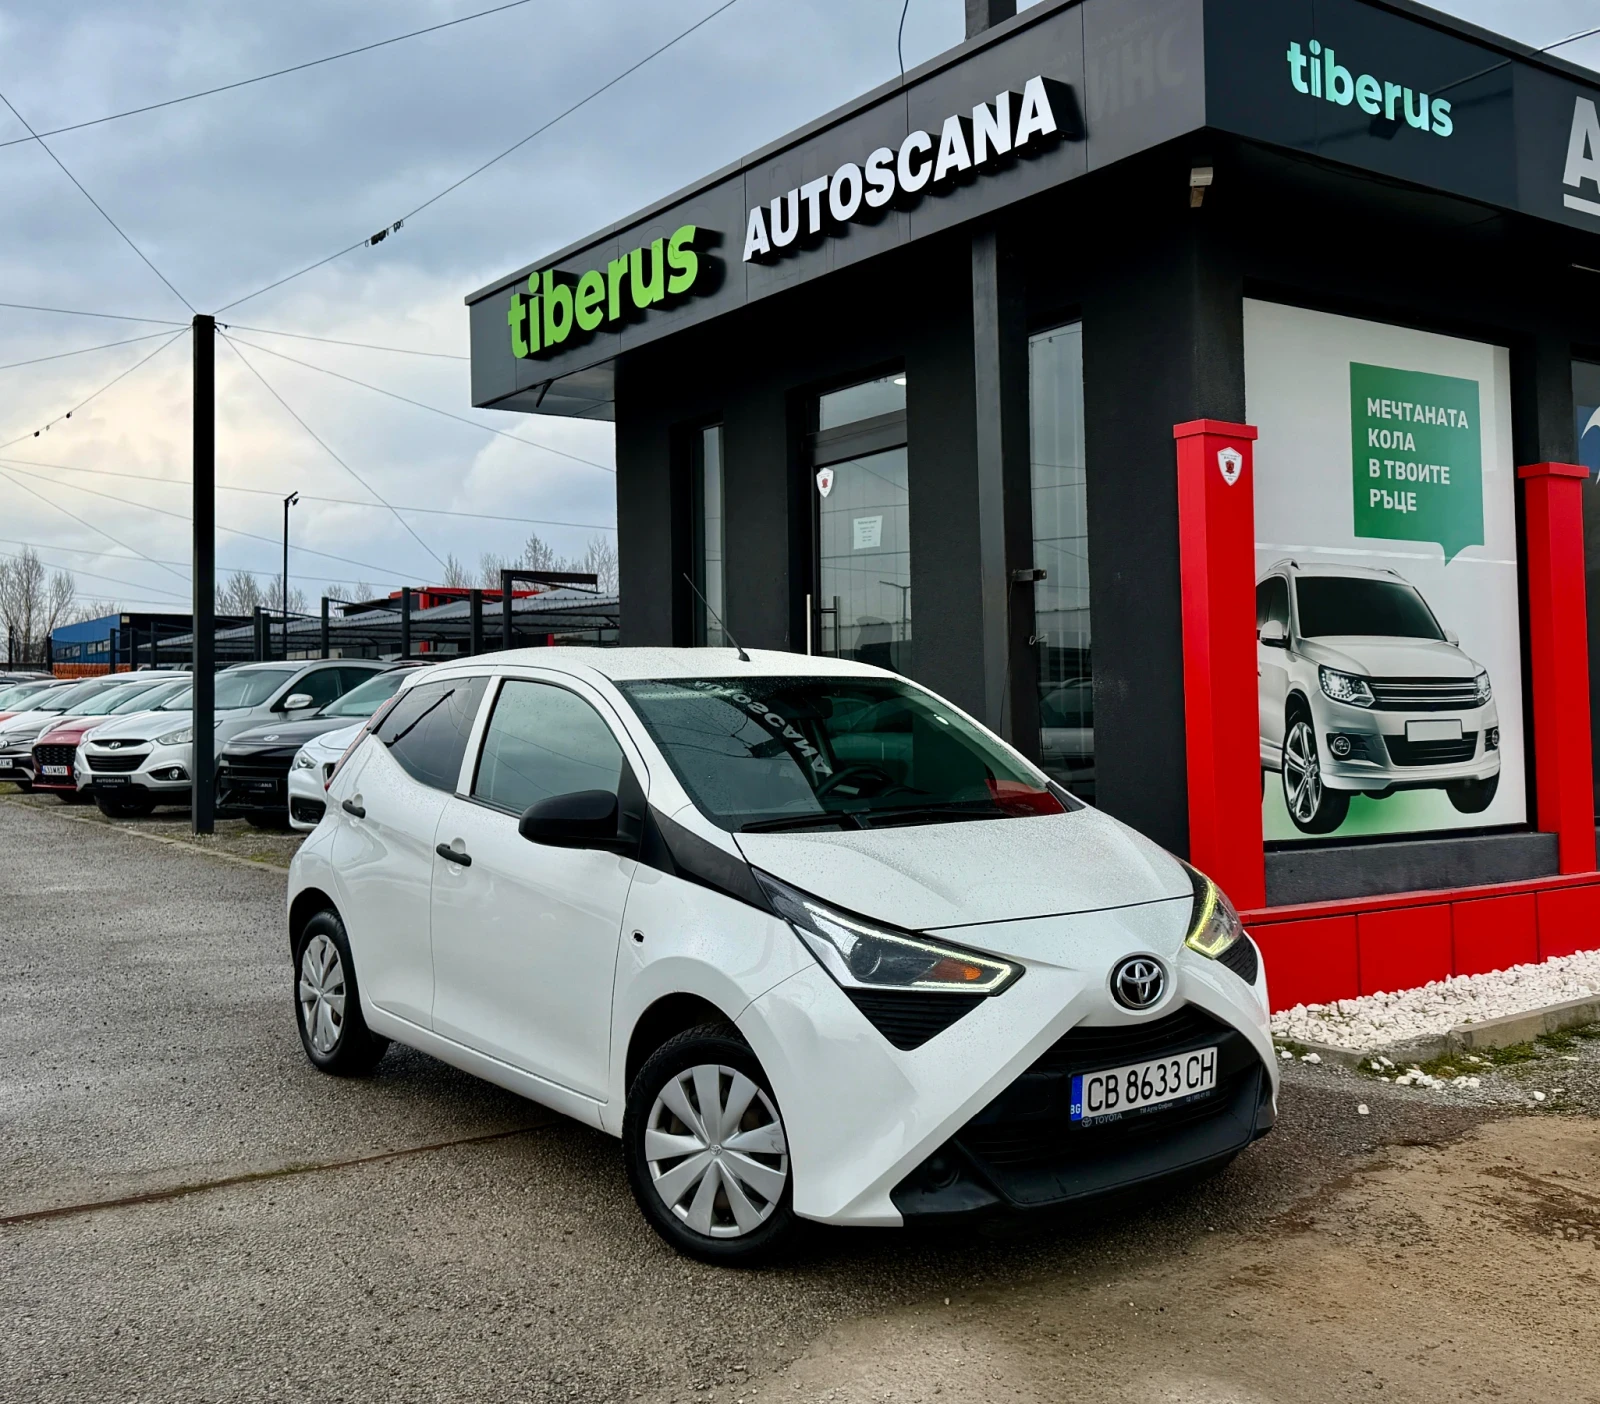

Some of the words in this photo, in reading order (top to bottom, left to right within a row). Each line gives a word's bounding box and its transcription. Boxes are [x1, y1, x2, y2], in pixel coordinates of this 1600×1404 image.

[1287, 39, 1454, 137] tiberus
[742, 75, 1058, 262] AUTOSCANA
[507, 225, 699, 359] tiberus
[1367, 397, 1469, 429] МЕЧТАНАТА
[1368, 428, 1416, 452] КОЛА
[1369, 458, 1381, 478] В
[1384, 460, 1451, 485] ТВОИТЕ
[1370, 489, 1417, 514] РЪЦЕ
[1087, 1074, 1119, 1112] CB
[1126, 1060, 1181, 1104] 8633
[1186, 1051, 1215, 1089] CH
[1095, 1112, 1123, 1125] TOYOTA
